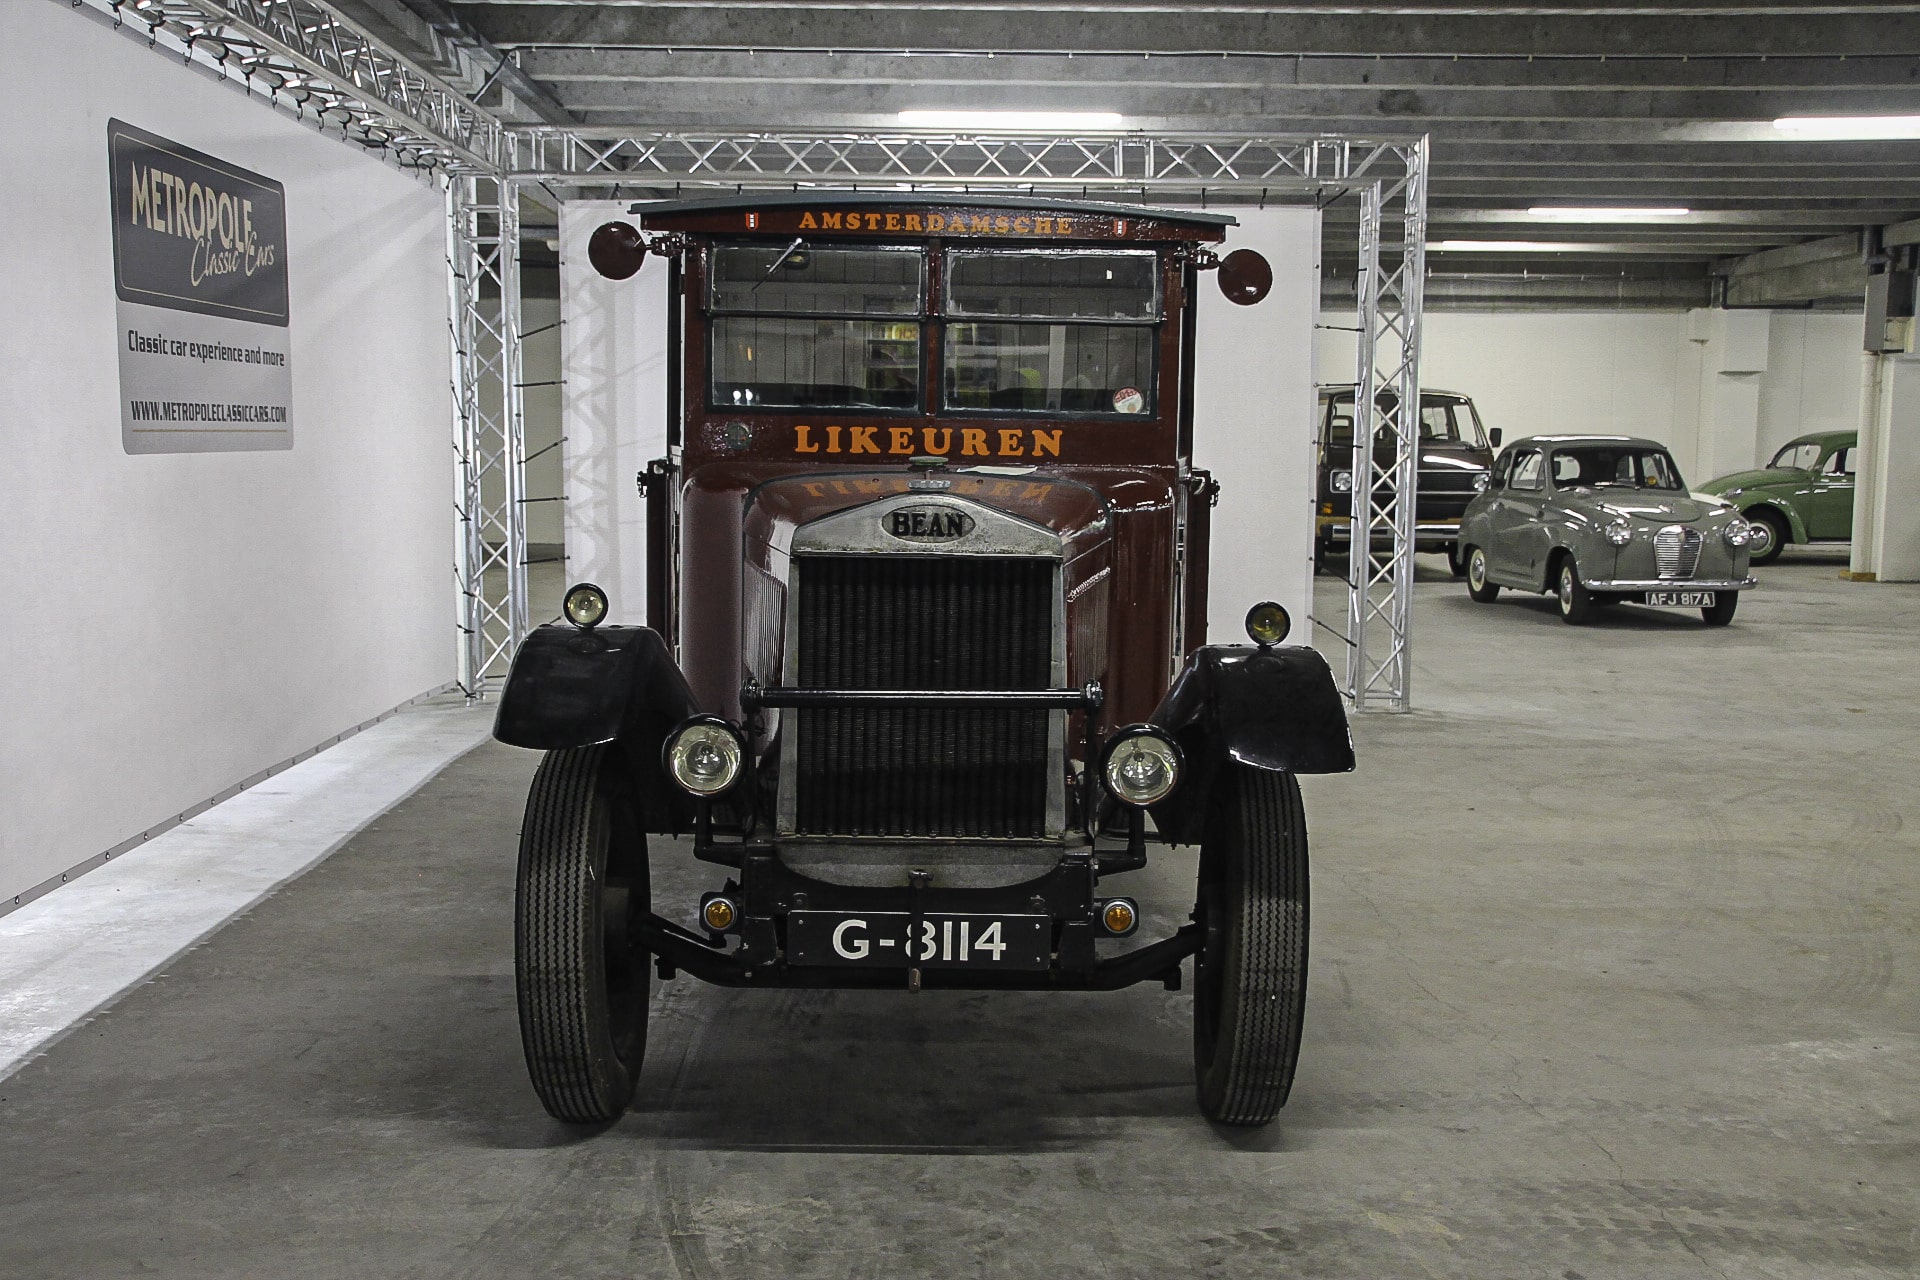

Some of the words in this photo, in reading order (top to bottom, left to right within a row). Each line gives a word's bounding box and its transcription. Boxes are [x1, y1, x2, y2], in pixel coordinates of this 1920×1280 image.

[132, 161, 255, 256] METROPOLE
[799, 211, 1073, 235] AMSTERDAMSCHE
[191, 237, 240, 287] Classic
[245, 231, 275, 277] Cars
[128, 330, 168, 355] Classic
[170, 340, 187, 357] car
[189, 341, 243, 363] experience
[244, 346, 261, 364] and
[263, 351, 285, 366] more
[131, 401, 287, 422] WWW.METROPOLECLASSICCARS.COM
[794, 425, 1064, 457] LIKEUREN
[892, 511, 965, 539] BEAN
[1650, 592, 1677, 606] AFJ
[1681, 592, 1711, 606] 817A
[832, 918, 1007, 962] G-8114
